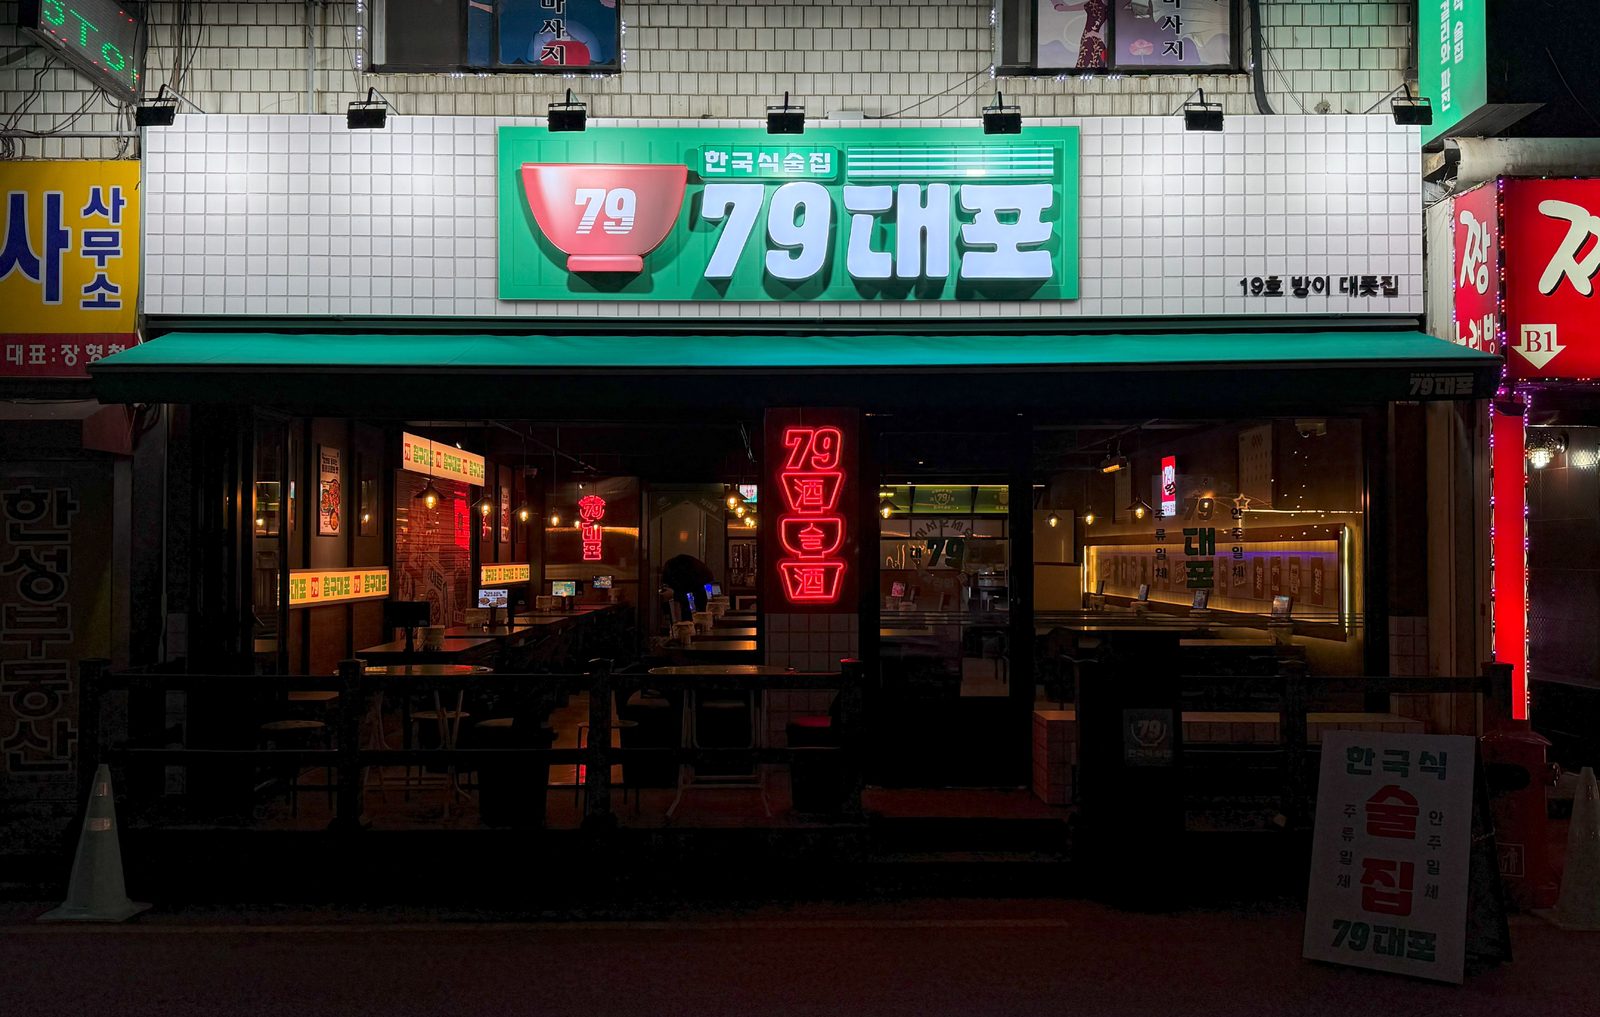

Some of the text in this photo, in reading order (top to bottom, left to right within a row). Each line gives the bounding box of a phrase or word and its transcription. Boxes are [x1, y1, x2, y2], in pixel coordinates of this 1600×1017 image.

[704, 150, 831, 174] 한국식술집
[574, 188, 637, 235] 79
[701, 182, 1054, 281] 79대포
[81, 186, 127, 309] 사무소
[1459, 210, 1491, 295] 짱
[1239, 275, 1284, 298] 19호
[1291, 275, 1331, 299] 방이
[1523, 330, 1556, 353] B1
[785, 428, 842, 470] 79
[583, 503, 602, 518] 79
[793, 478, 825, 507] 酒
[798, 521, 826, 550] 술
[793, 566, 825, 596] 酒
[0, 485, 80, 774] 한성부동산
[1346, 746, 1448, 781] 한국식
[1335, 803, 1357, 890] 주류일체
[1359, 784, 1420, 917] 술집
[1423, 810, 1445, 900] 안주일체
[1331, 918, 1437, 963] 79대포
